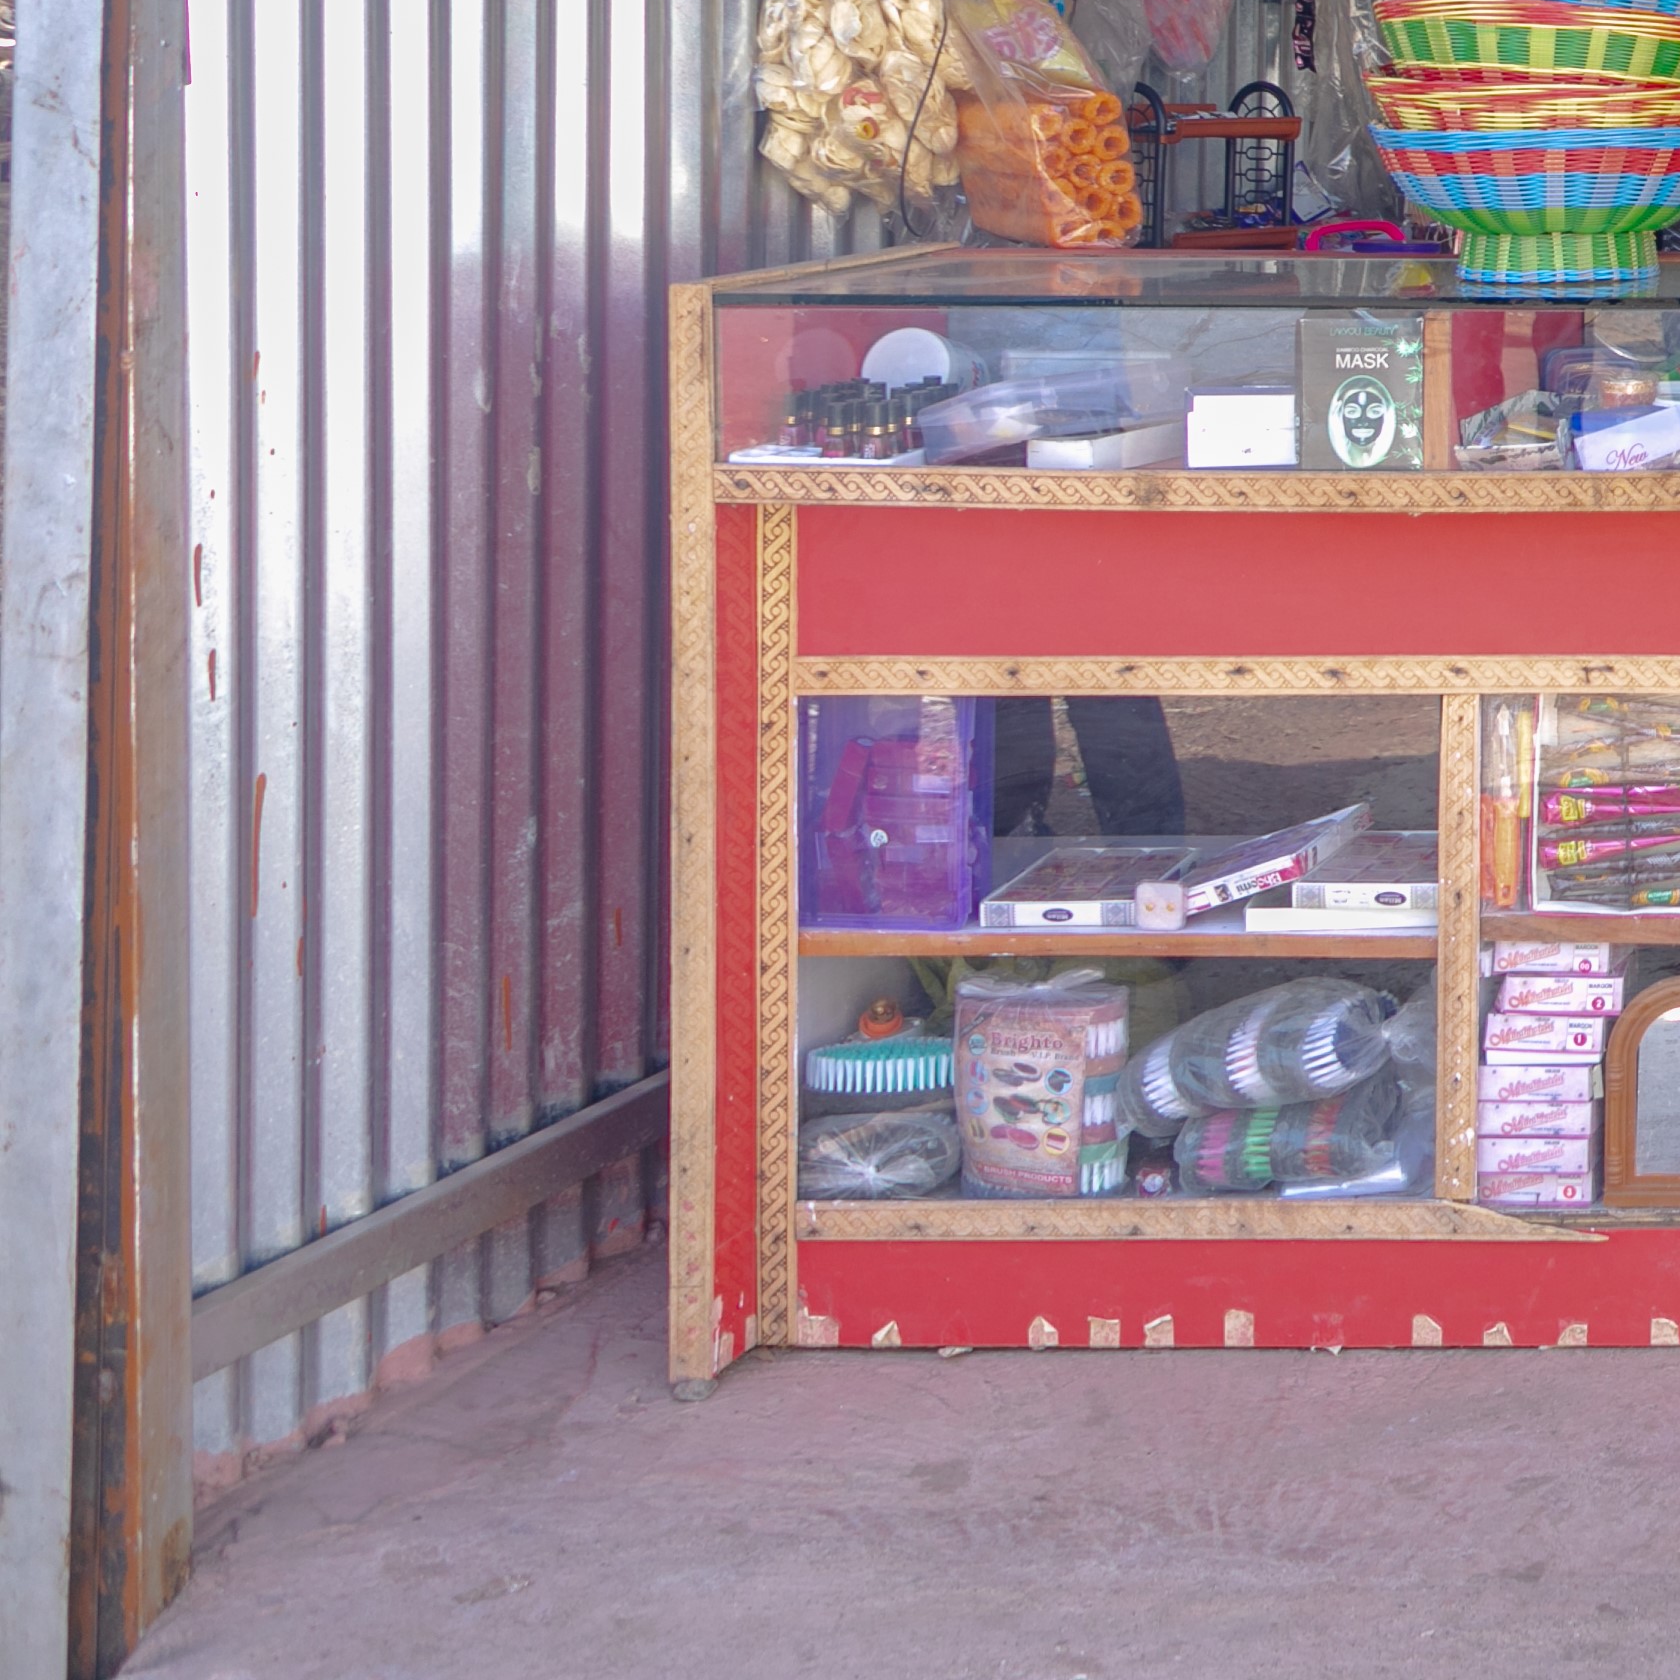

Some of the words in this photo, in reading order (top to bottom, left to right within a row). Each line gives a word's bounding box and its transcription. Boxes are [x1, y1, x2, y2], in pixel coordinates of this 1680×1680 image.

[1335, 353, 1389, 370] MASK
[1606, 443, 1648, 471] New
[1594, 999, 1603, 1008] 2
[990, 1032, 1064, 1053] Brighto
[1017, 1169, 1072, 1184] PRODUCTS
